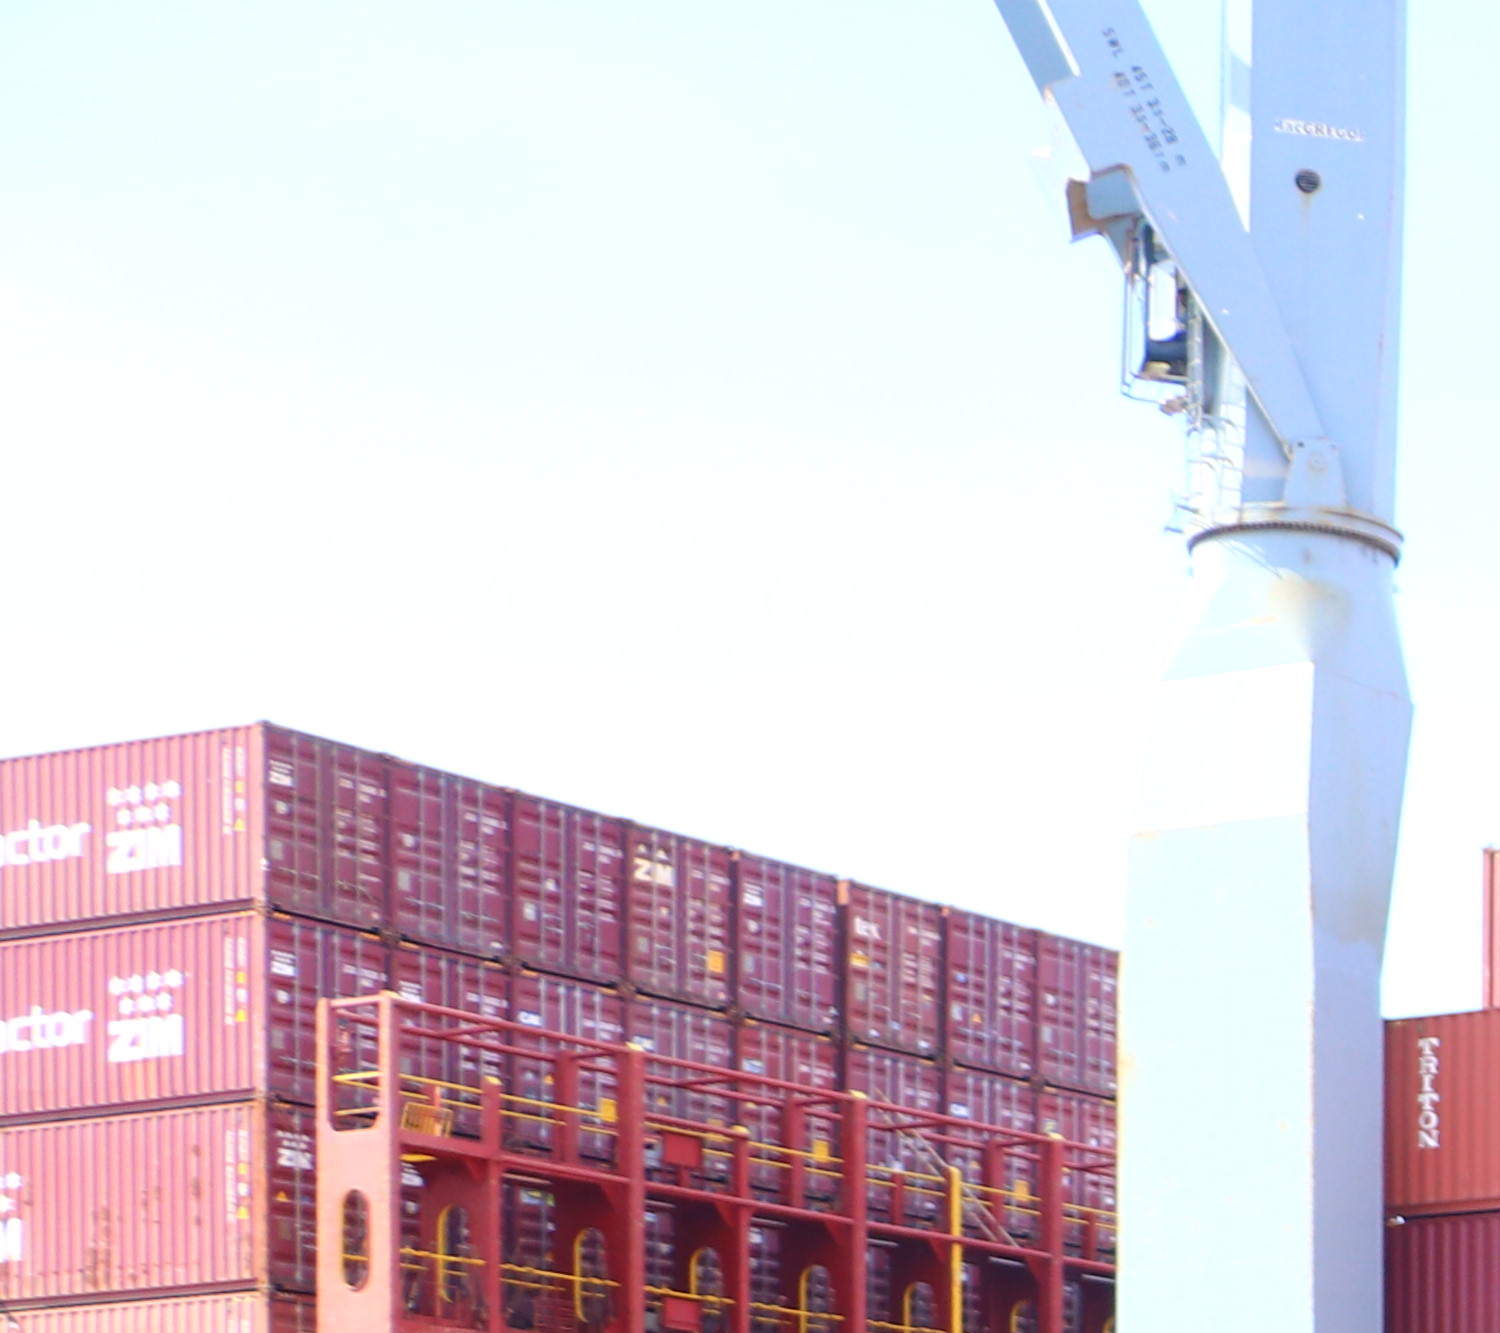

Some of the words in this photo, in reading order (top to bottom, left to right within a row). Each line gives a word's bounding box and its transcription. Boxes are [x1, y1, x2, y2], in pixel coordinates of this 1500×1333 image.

[0, 818, 92, 868] ctor
[106, 824, 182, 875] ZIM
[634, 857, 674, 887] ZM
[0, 1005, 94, 1052] ctor
[107, 1013, 184, 1063] ZIM
[1417, 1036, 1441, 1149] TRITON
